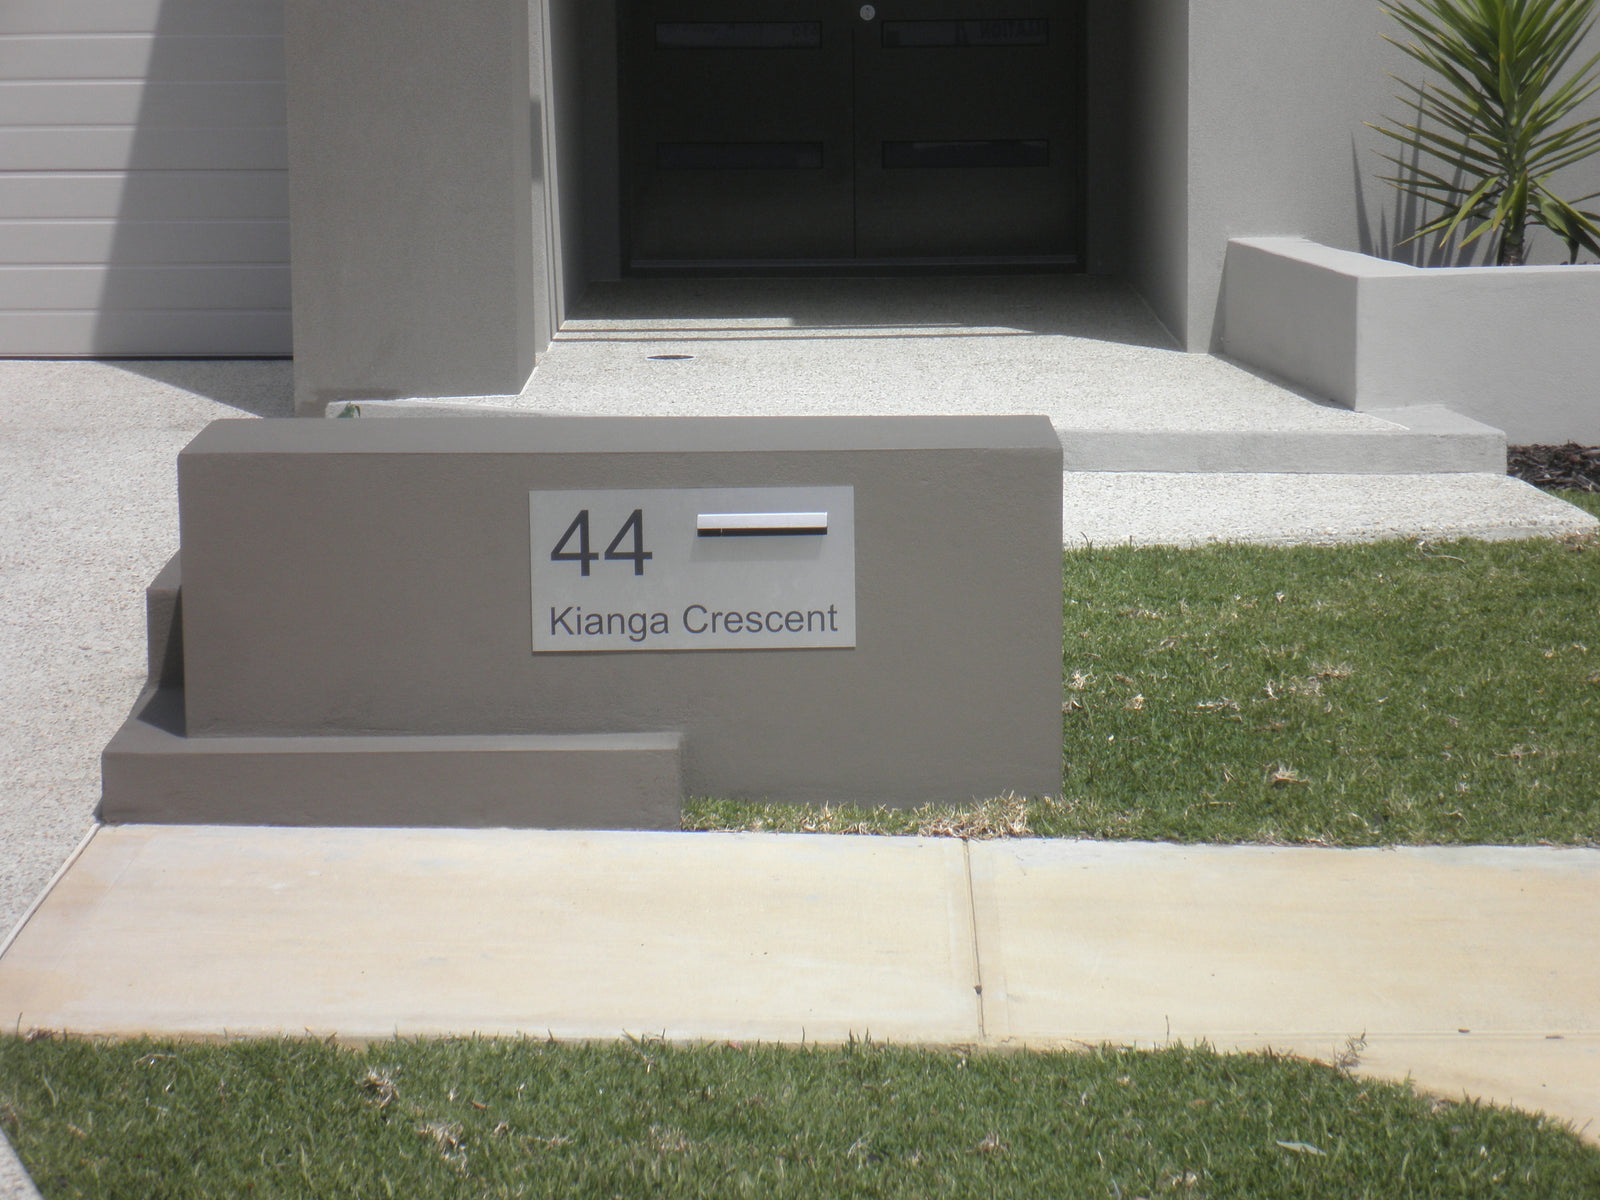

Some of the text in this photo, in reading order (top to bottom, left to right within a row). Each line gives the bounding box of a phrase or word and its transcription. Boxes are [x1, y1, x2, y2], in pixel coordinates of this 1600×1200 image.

[550, 508, 653, 577] 44
[550, 604, 838, 643] Kianga Crescent
